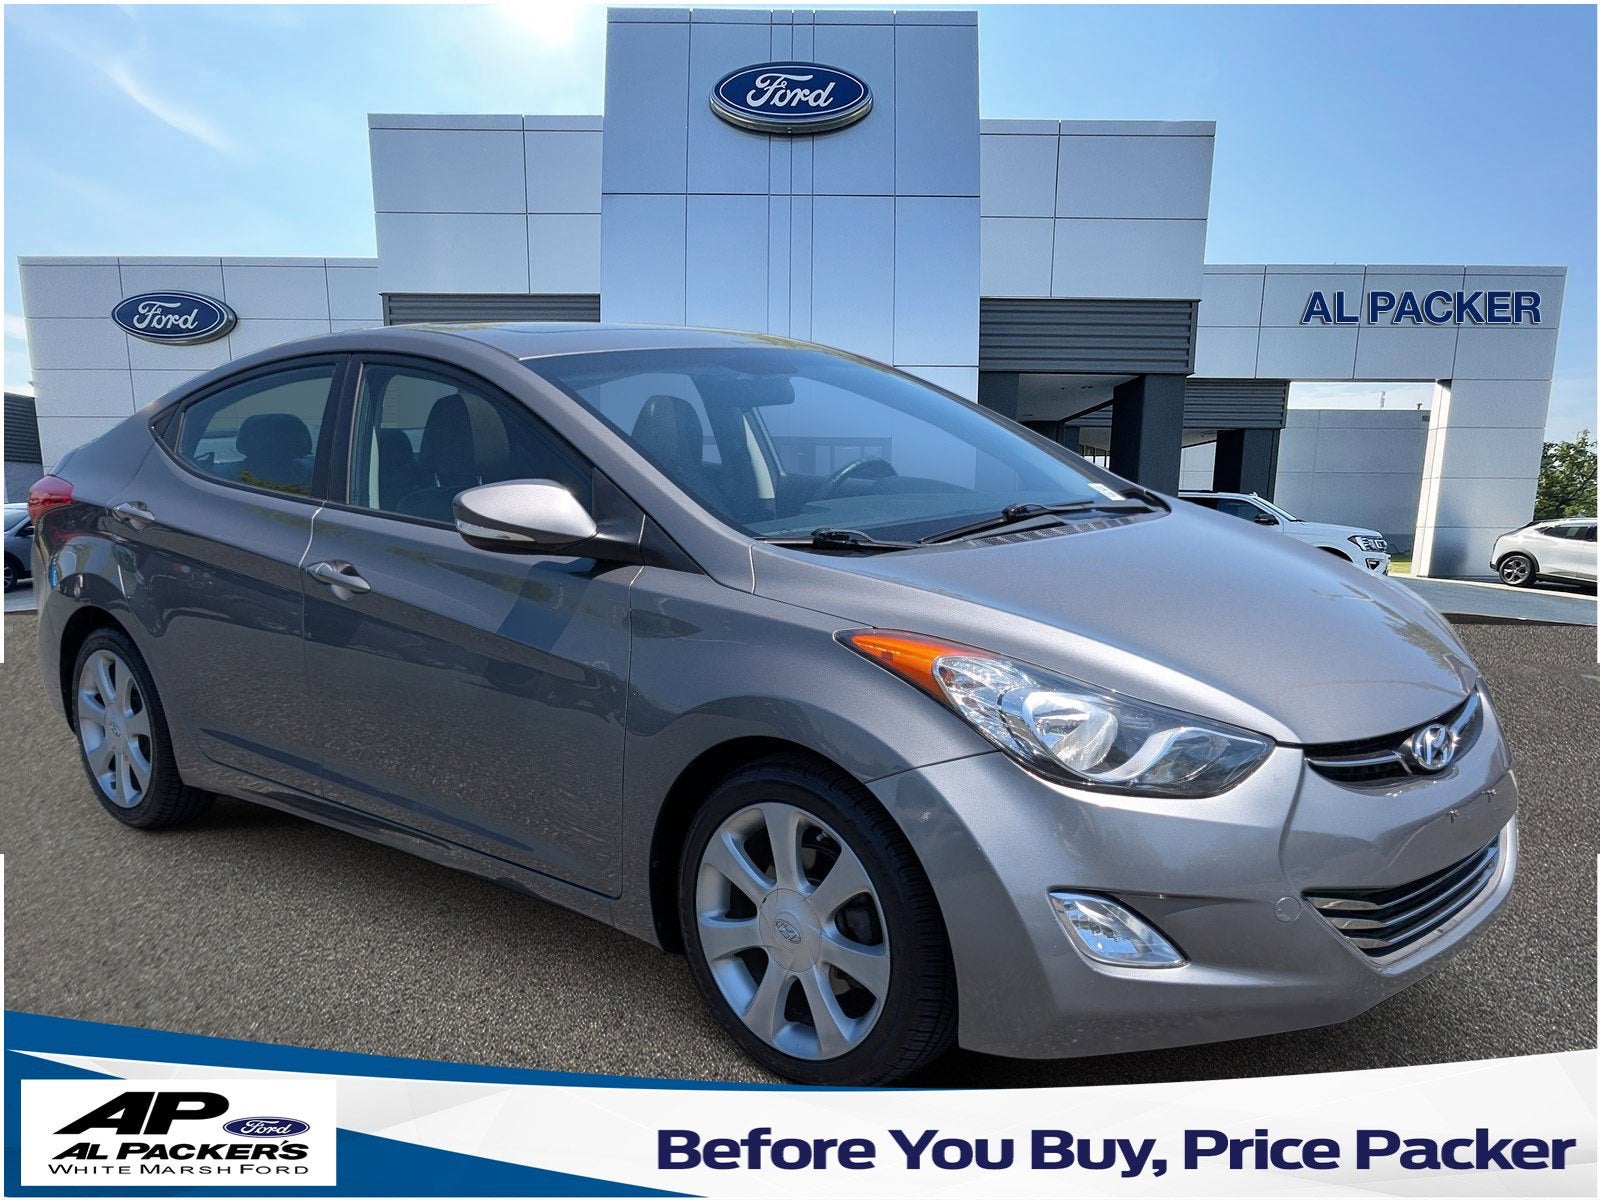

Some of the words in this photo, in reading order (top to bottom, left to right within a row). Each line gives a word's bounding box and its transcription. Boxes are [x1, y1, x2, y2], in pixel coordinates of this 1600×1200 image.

[746, 73, 836, 108] Ford
[133, 301, 199, 329] Ford
[1301, 291, 1359, 324] AL
[1368, 290, 1542, 325] PACKER
